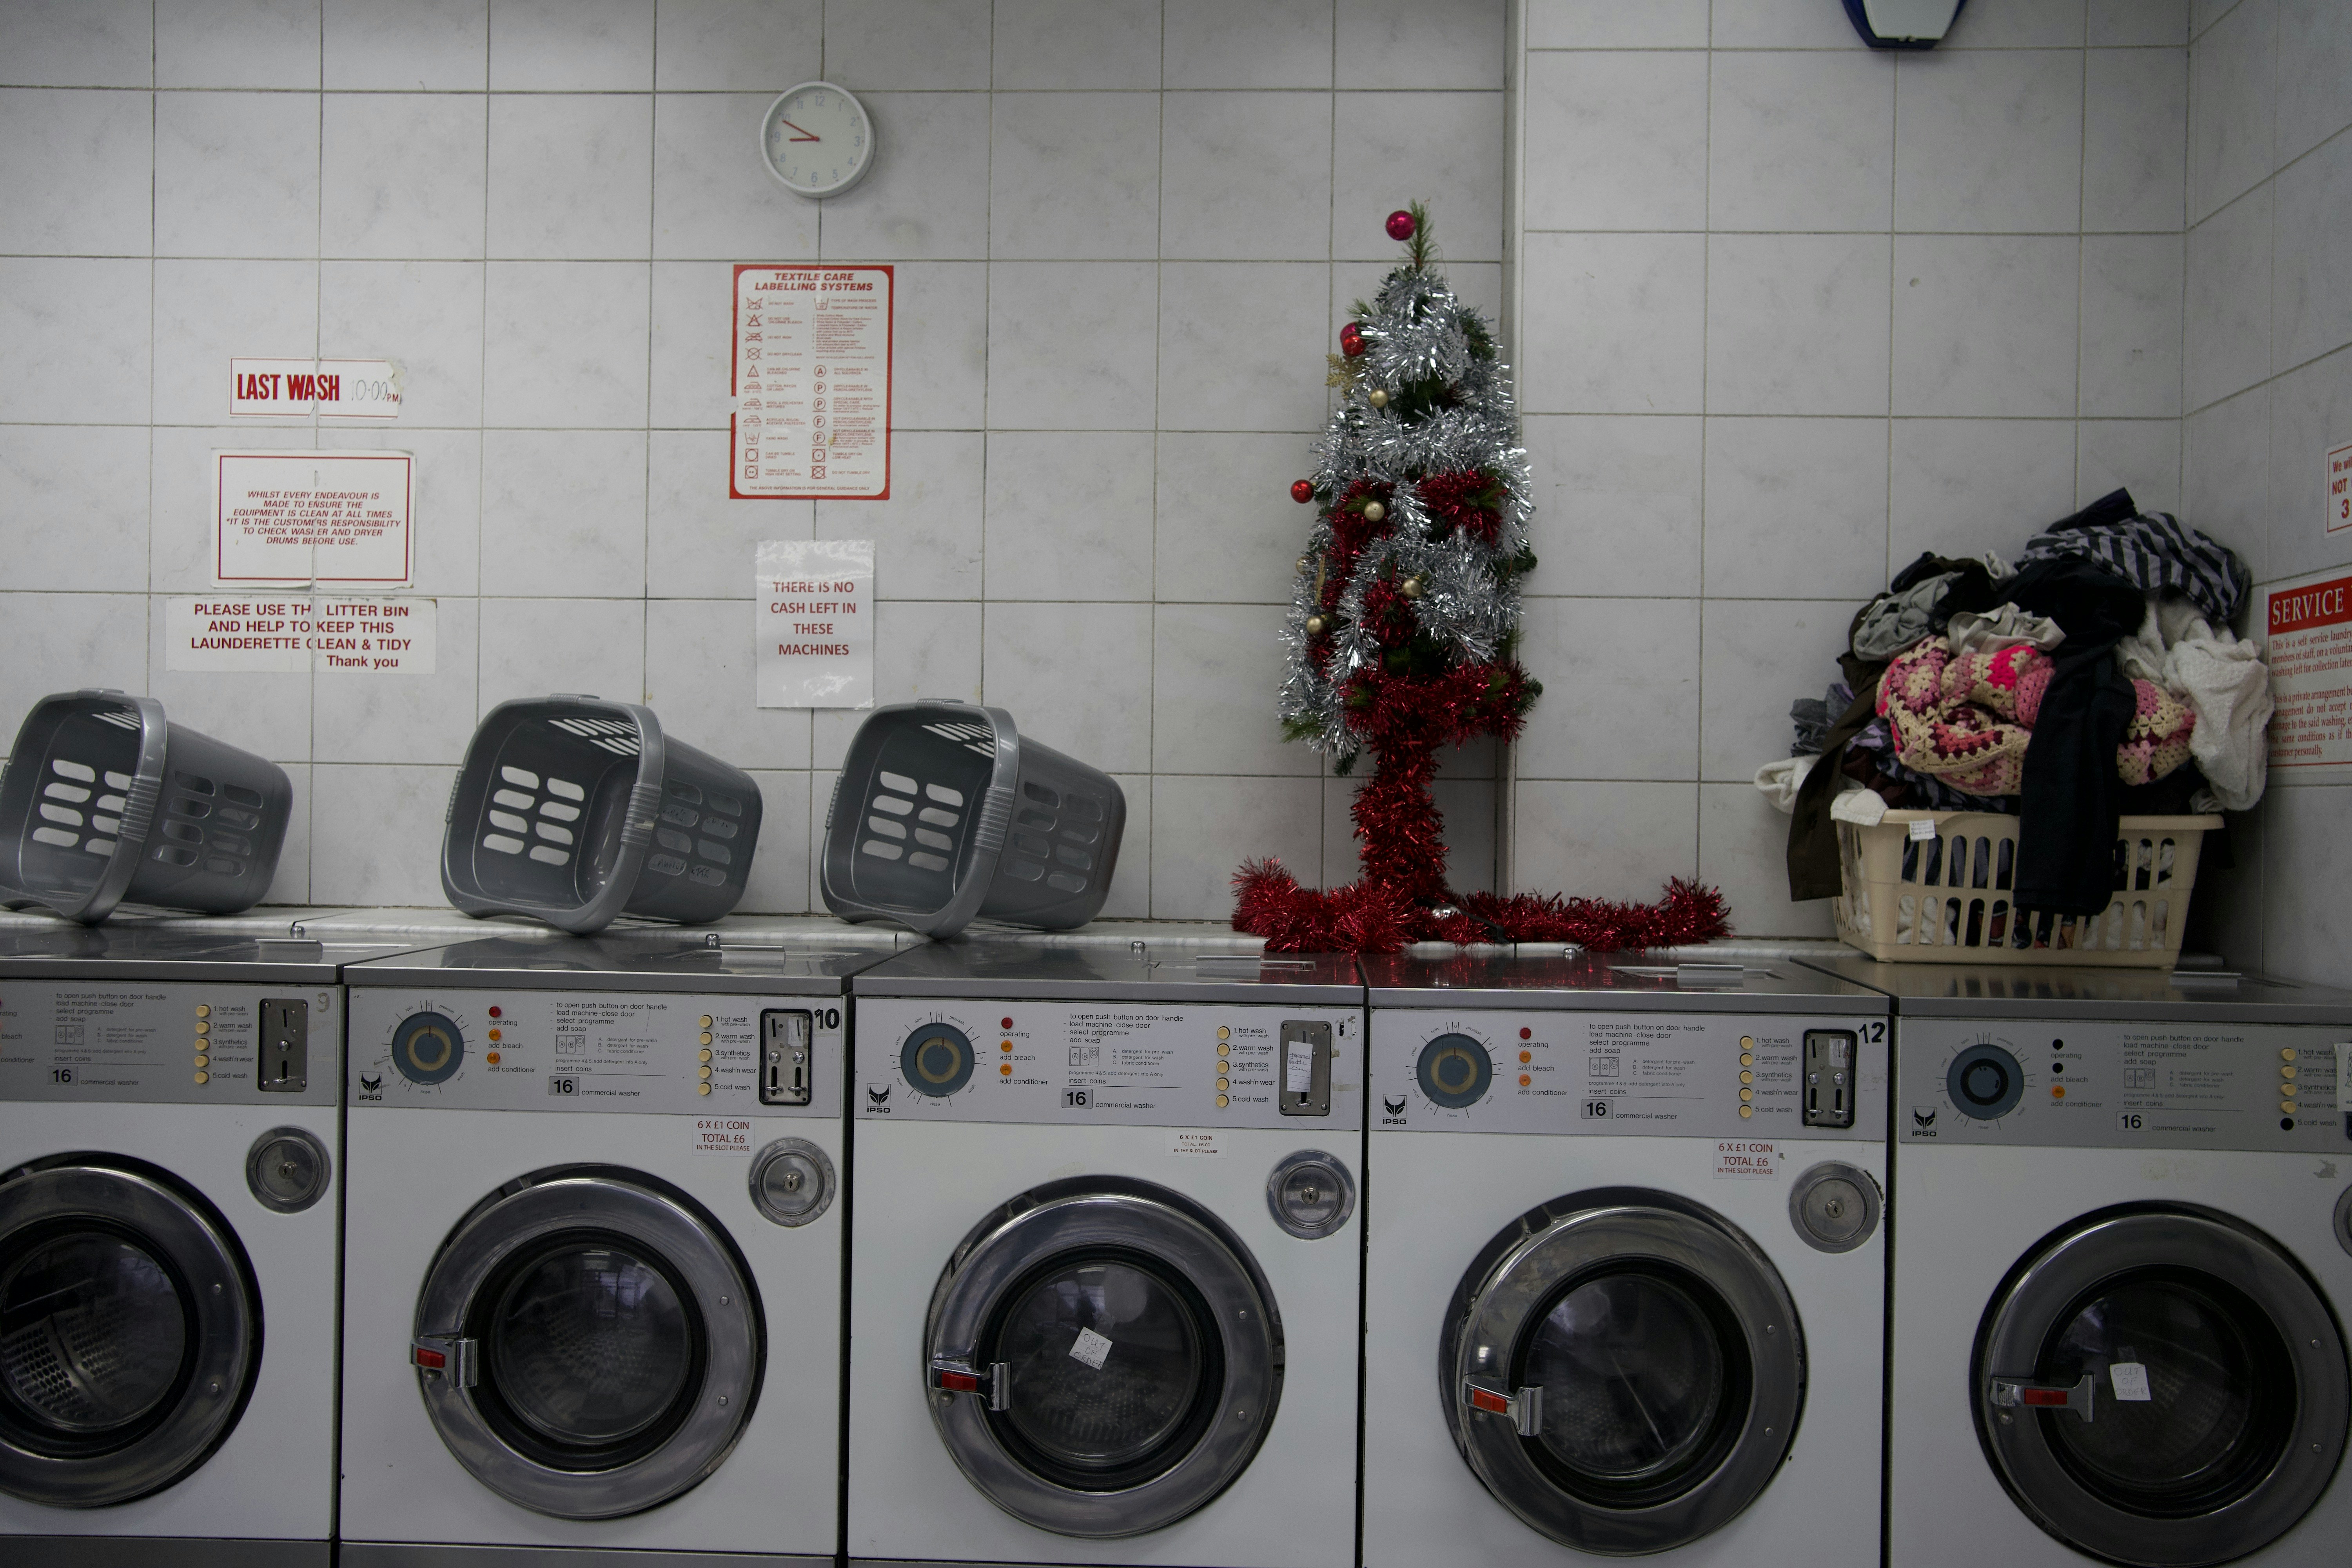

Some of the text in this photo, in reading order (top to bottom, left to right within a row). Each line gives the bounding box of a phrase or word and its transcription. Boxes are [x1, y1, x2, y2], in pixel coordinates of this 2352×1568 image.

[797, 100, 803, 109] 11
[815, 96, 825, 107] 12
[850, 117, 856, 126] 2
[774, 132, 780, 142] 9
[854, 136, 860, 147] 3
[780, 153, 786, 162] 8
[848, 157, 853, 165] 4
[793, 167, 798, 176] 7
[811, 172, 817, 182] 6
[833, 169, 838, 178] 5
[238, 374, 281, 399] LAST
[287, 375, 339, 401] WASH
[2333, 460, 2341, 473] We
[2332, 478, 2347, 495] NOT
[2341, 499, 2349, 519] 3
[773, 582, 854, 592] THERE IS NO
[195, 604, 408, 616] PLEASE USE TH LITTER BIN
[771, 603, 855, 613] CASH LEFT IN
[2273, 588, 2343, 625] SERVICE
[209, 621, 394, 633] AND HELP TO KEEP THIS
[793, 624, 833, 634] THESE
[192, 638, 299, 648] LAUNDERETTE
[362, 639, 370, 650] &
[377, 639, 410, 650] TIDY
[2273, 640, 2283, 650] This
[2286, 639, 2289, 647] is
[2298, 634, 2307, 646] self
[2310, 632, 2328, 644] service
[779, 644, 849, 655] MACHINES
[327, 655, 398, 670] Thank you
[814, 1008, 840, 1029] 10
[1859, 1022, 1886, 1044] 12
[53, 1069, 71, 1083] 16
[554, 1080, 572, 1093] 16
[1067, 1092, 1086, 1105] 16
[1586, 1102, 1606, 1116] 16
[727, 1121, 749, 1130] COIN
[2121, 1114, 2142, 1129] 16
[702, 1134, 745, 1143] TOTAL £6
[1719, 1143, 1724, 1151] 6
[1749, 1143, 1773, 1152] COIN
[1723, 1156, 1768, 1166] TOTAL £6
[1084, 1334, 1107, 1350] OUT
[1085, 1347, 1098, 1355] OF
[1074, 1352, 1102, 1368] ORDER
[2114, 1367, 2141, 1376] OUT
